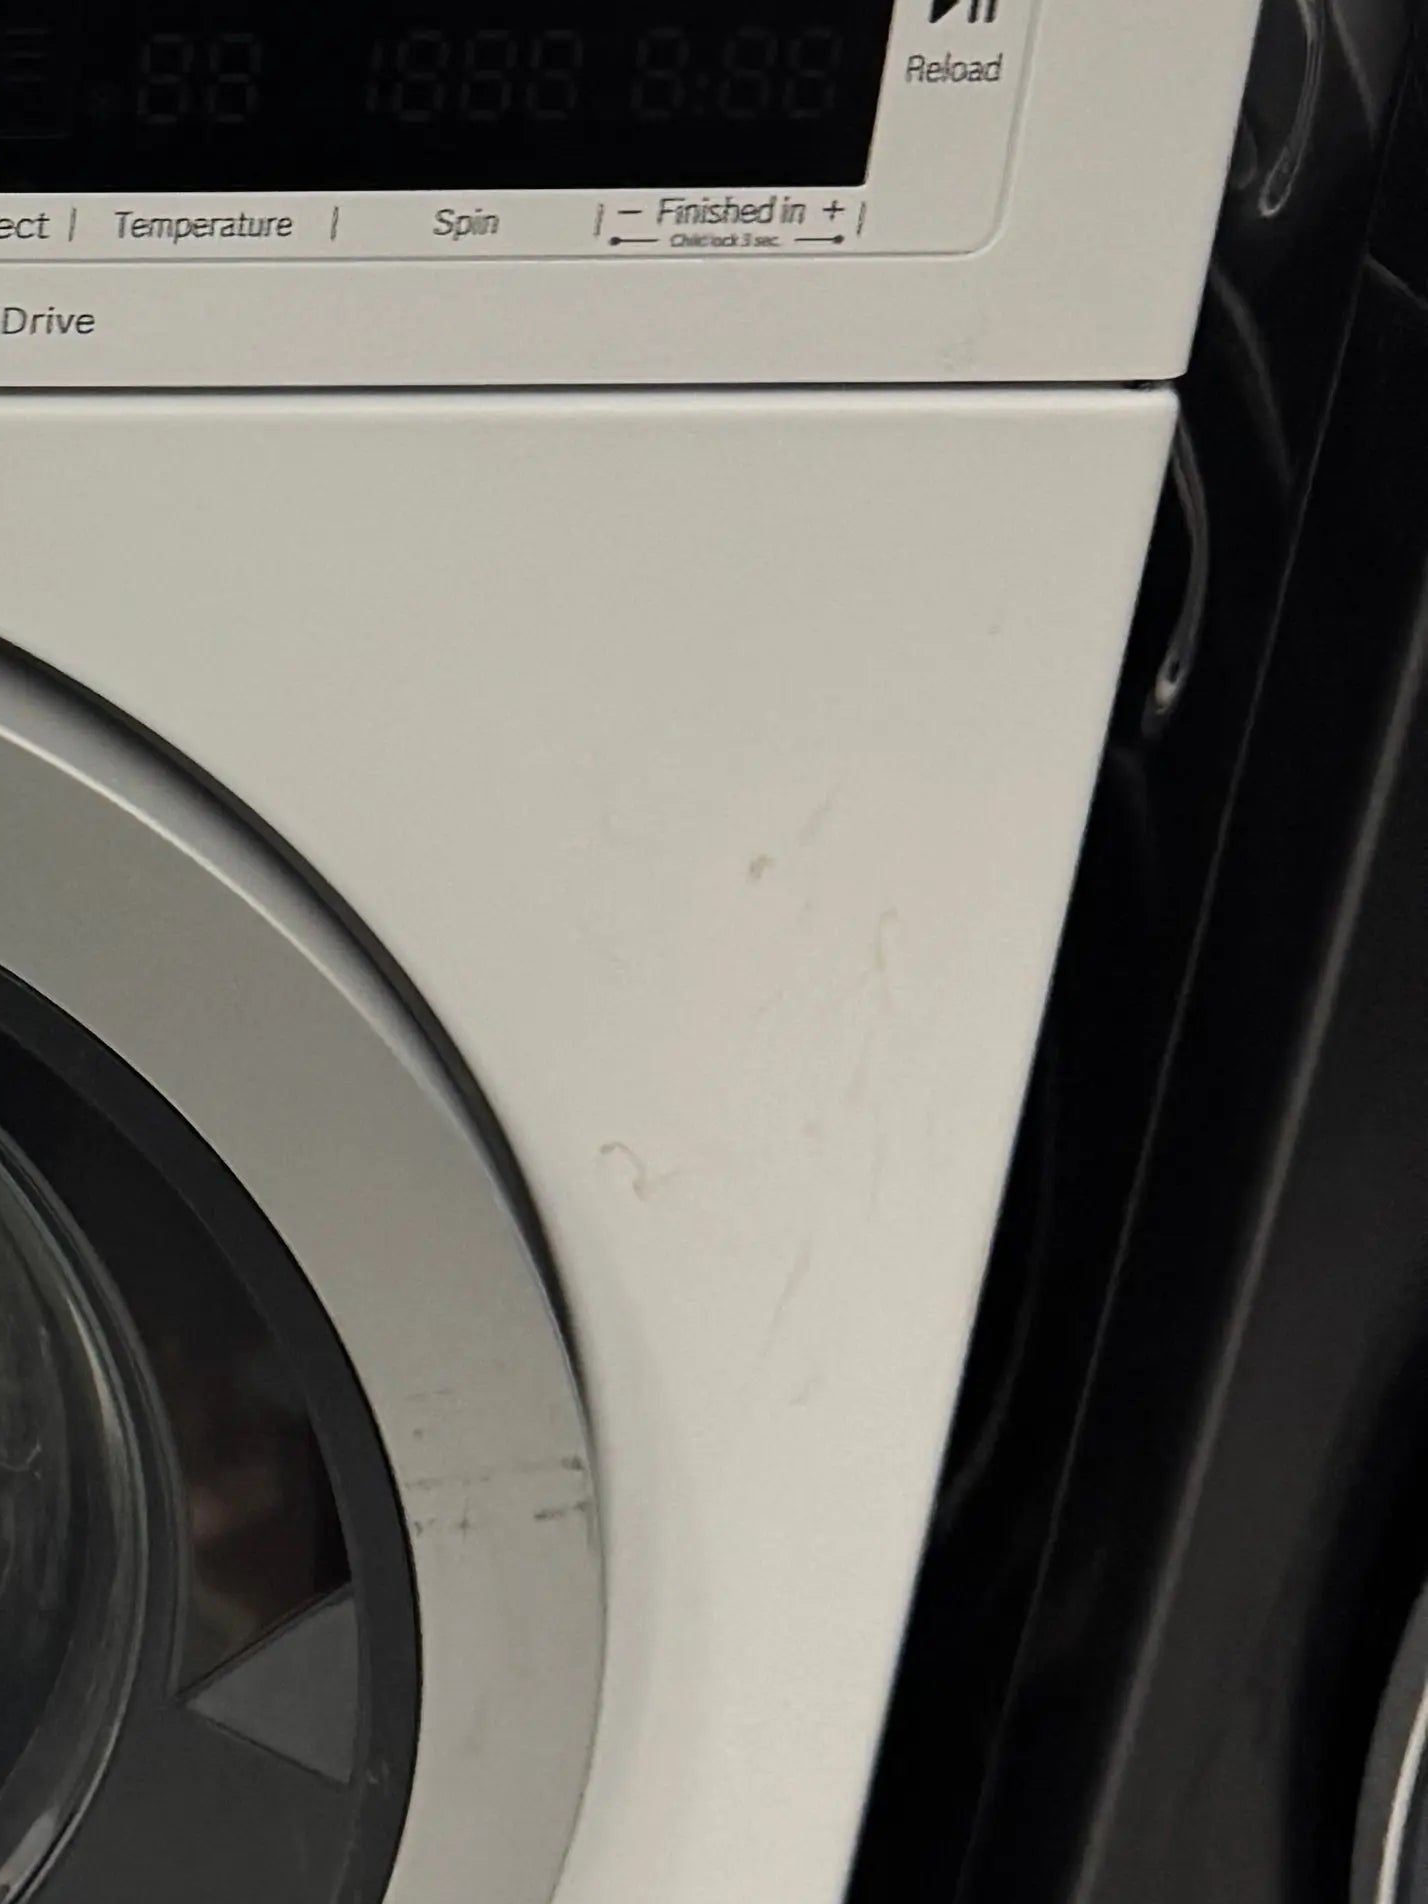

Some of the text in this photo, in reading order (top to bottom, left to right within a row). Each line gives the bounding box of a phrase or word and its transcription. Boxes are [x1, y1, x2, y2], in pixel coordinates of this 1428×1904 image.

[905, 52, 1004, 84] Reload
[433, 208, 499, 240] Spin
[656, 194, 806, 225] Finished in
[115, 211, 294, 244] Temperature
[1, 306, 95, 335] Drive
